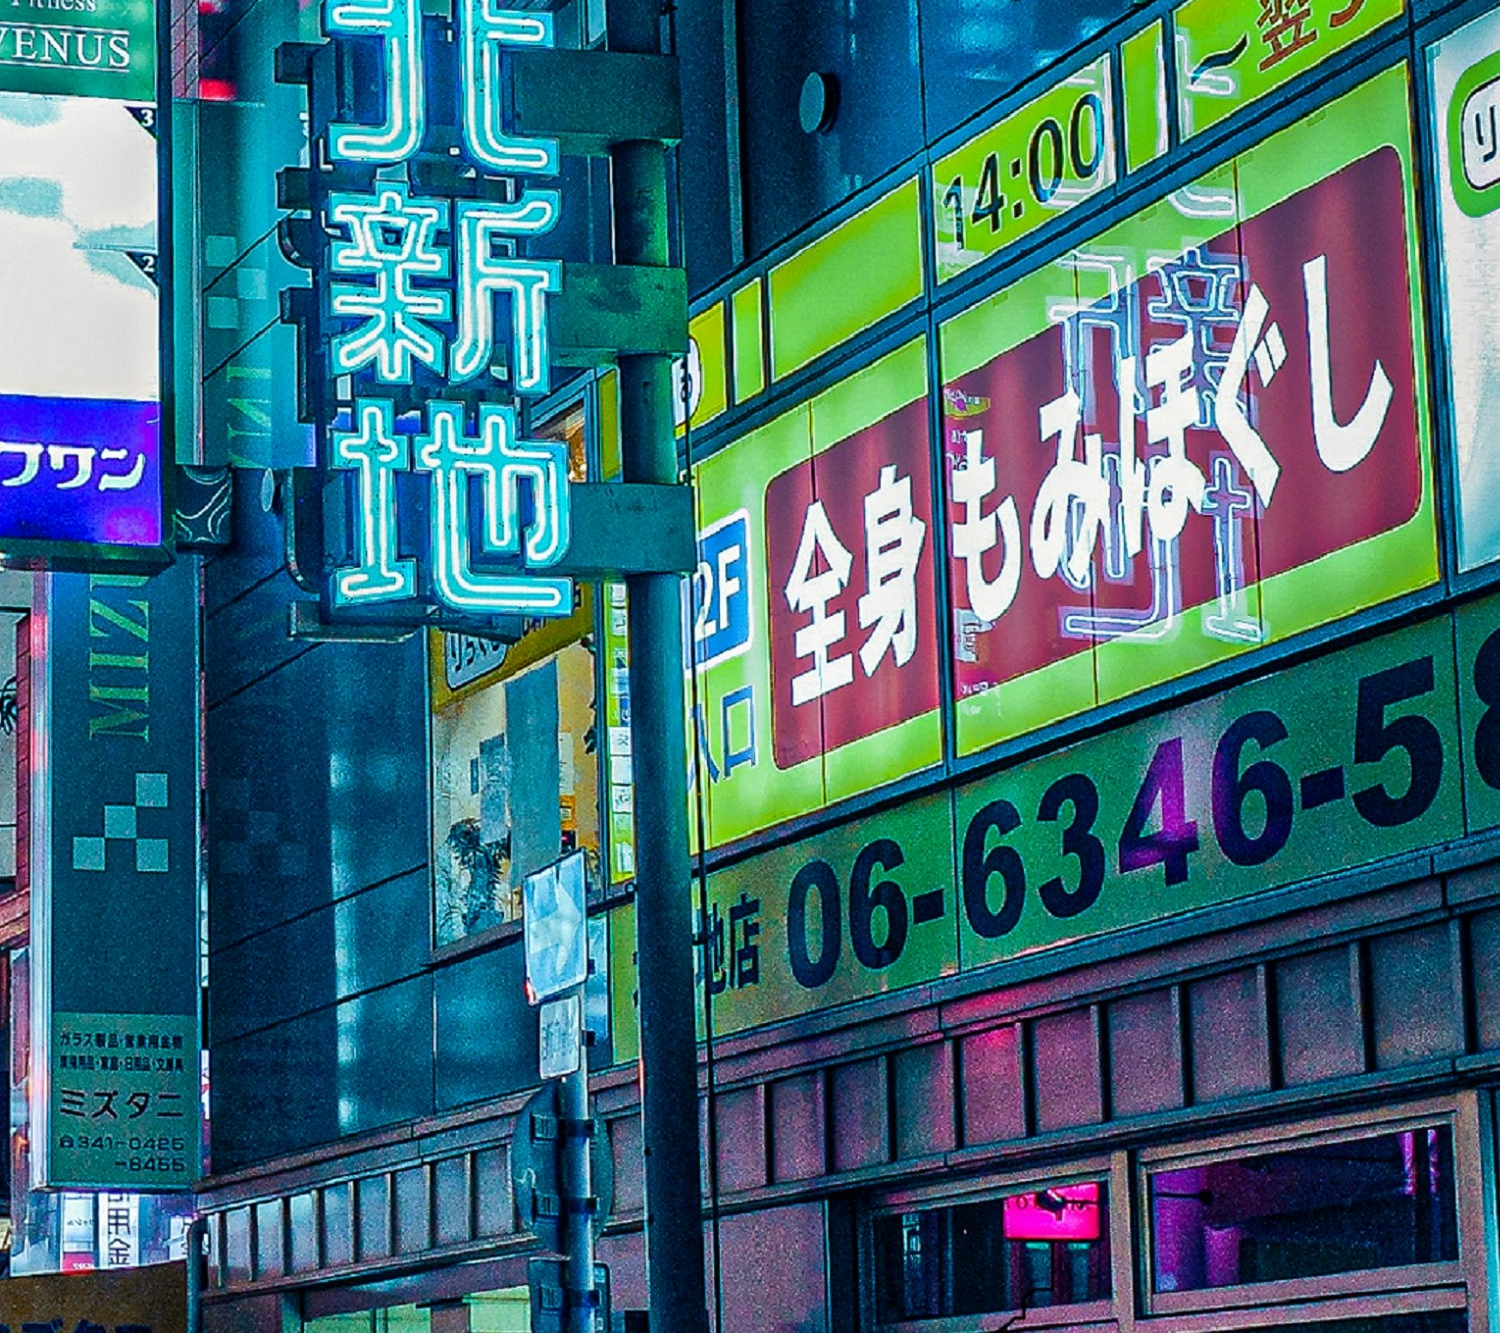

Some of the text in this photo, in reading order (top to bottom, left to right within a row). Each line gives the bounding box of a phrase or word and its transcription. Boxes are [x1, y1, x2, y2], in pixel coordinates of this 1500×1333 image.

[141, 107, 154, 127] 3
[941, 99, 1104, 252] 14:00
[142, 254, 155, 272] 2
[785, 254, 1394, 704] 全身もみほぐし
[59, 1089, 184, 1119] ミズタニ
